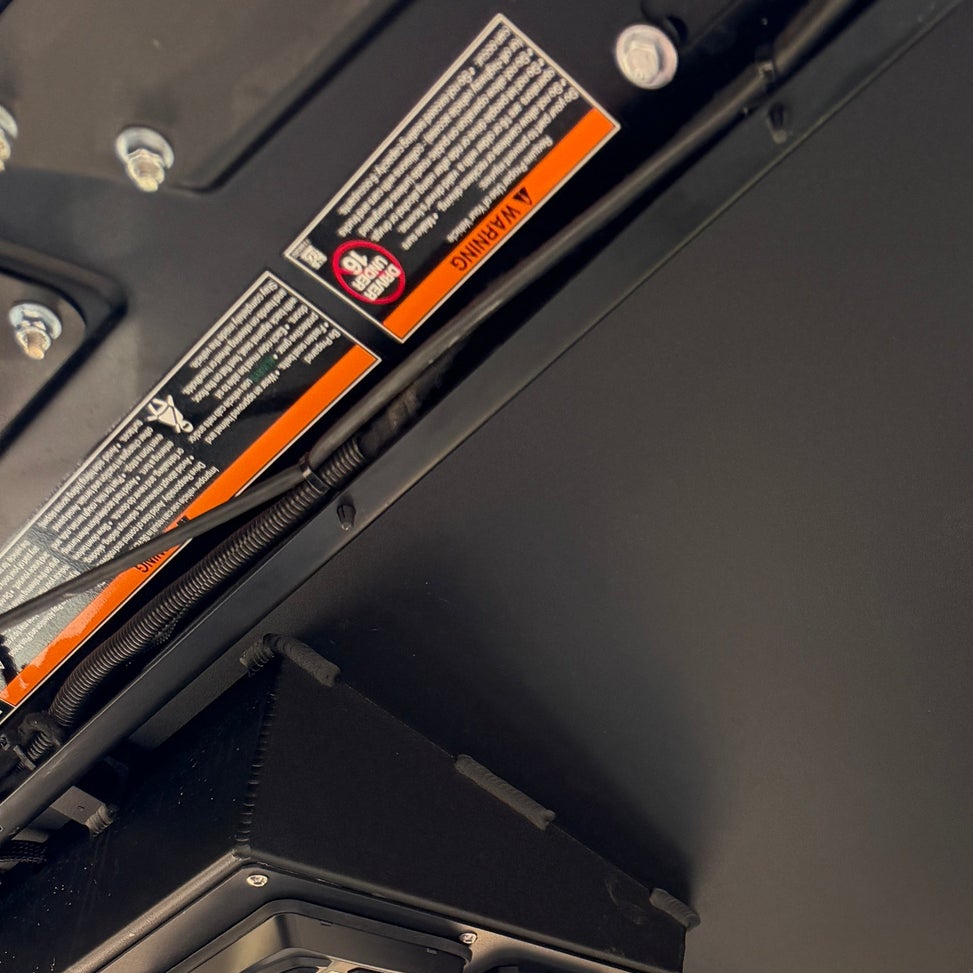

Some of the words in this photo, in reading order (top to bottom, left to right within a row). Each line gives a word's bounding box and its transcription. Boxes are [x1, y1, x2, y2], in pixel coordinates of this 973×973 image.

[520, 133, 555, 167] Require
[499, 158, 530, 189] Proper
[478, 193, 496, 209] of
[486, 180, 509, 202] Use
[465, 201, 488, 223] Your
[443, 215, 474, 245] Vehicle
[448, 201, 522, 273] WARNING
[337, 246, 372, 277] 16
[348, 252, 390, 293] UNDER
[361, 262, 402, 302] DRIVER
